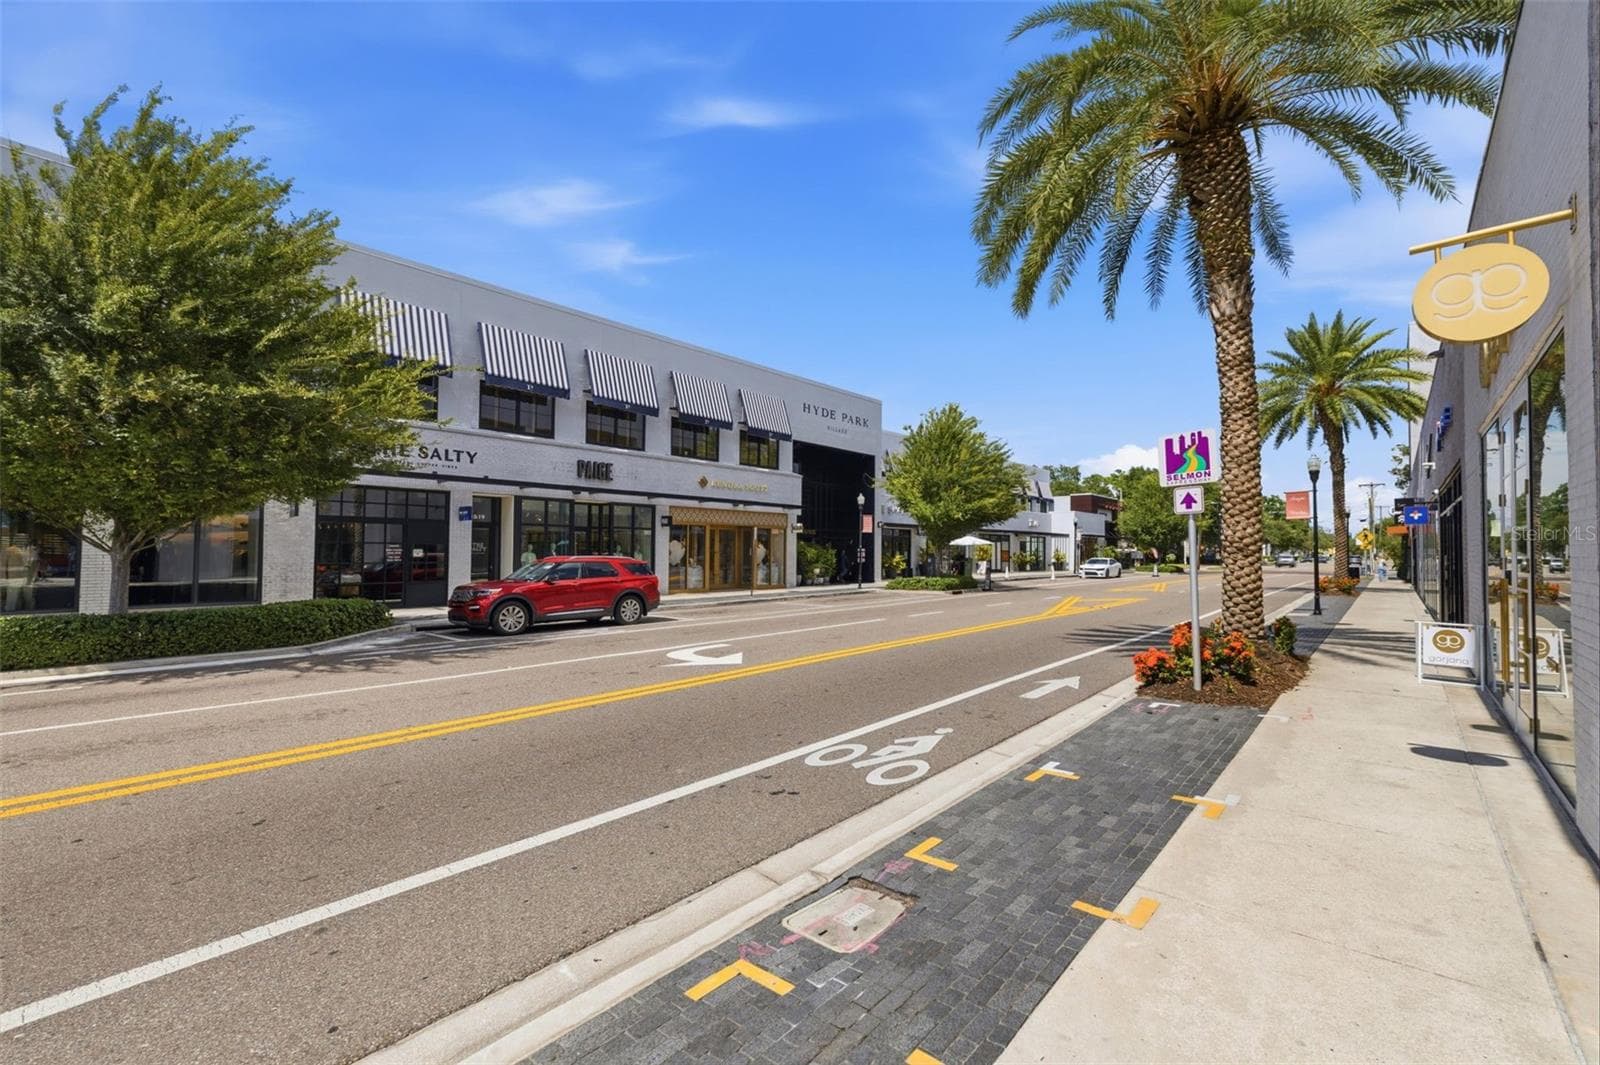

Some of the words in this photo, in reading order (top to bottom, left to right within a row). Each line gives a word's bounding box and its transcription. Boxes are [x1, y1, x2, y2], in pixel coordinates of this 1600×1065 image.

[803, 402, 836, 420] HYDE
[841, 412, 869, 428] PARK
[418, 446, 478, 464] SALTY
[577, 459, 614, 481] PAIGE
[1166, 470, 1212, 482] SELMON
